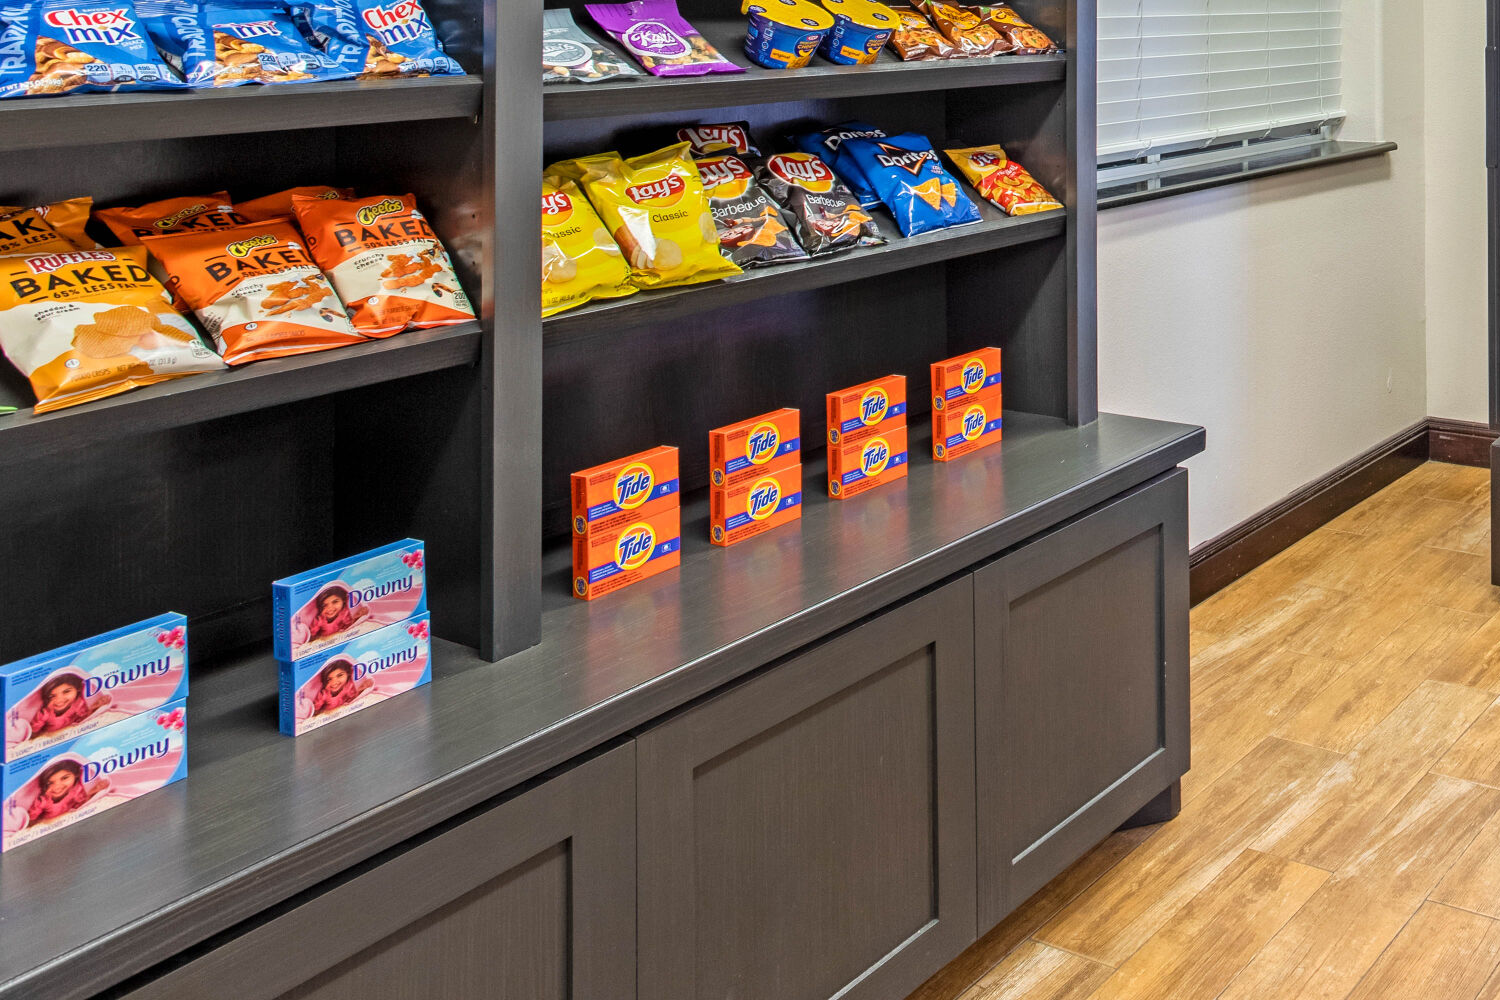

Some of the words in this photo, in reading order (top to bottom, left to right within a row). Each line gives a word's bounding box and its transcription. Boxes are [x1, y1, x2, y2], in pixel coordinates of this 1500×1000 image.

[45, 8, 129, 28] Chex
[87, 64, 108, 72] 220
[261, 54, 275, 63] 220
[825, 129, 888, 151] Doritos
[780, 157, 827, 183] Lay's
[877, 149, 939, 168] Doritos
[627, 175, 681, 203] Lay's
[358, 200, 403, 225] Cheetos
[652, 209, 689, 223] Classic
[24, 233, 57, 244] LESS
[334, 219, 433, 247] BAKED
[364, 241, 384, 249] 50%
[386, 239, 409, 247] LESS
[228, 235, 278, 257] Cheetos
[26, 251, 117, 274] RUFFLES
[354, 253, 385, 266] crunchy
[356, 257, 383, 270] cheese
[10, 264, 152, 298] BAKED
[242, 269, 264, 278] 50%
[53, 288, 80, 299] 65%
[85, 282, 115, 294] LESS
[118, 281, 137, 289] FAT
[34, 305, 67, 318] cheddar
[37, 311, 55, 321] sour
[56, 307, 80, 317] cream
[963, 367, 985, 390] Tide
[862, 396, 886, 421] Tide
[964, 414, 985, 437] Tide
[750, 432, 777, 461] Tide
[863, 447, 887, 473] Tide
[616, 473, 650, 506] Tide
[750, 487, 778, 516] Tide
[618, 532, 652, 566] Tide
[348, 574, 414, 609] Downy
[352, 645, 418, 682] Downy
[84, 656, 171, 698] Downy
[82, 738, 170, 783] Downy
